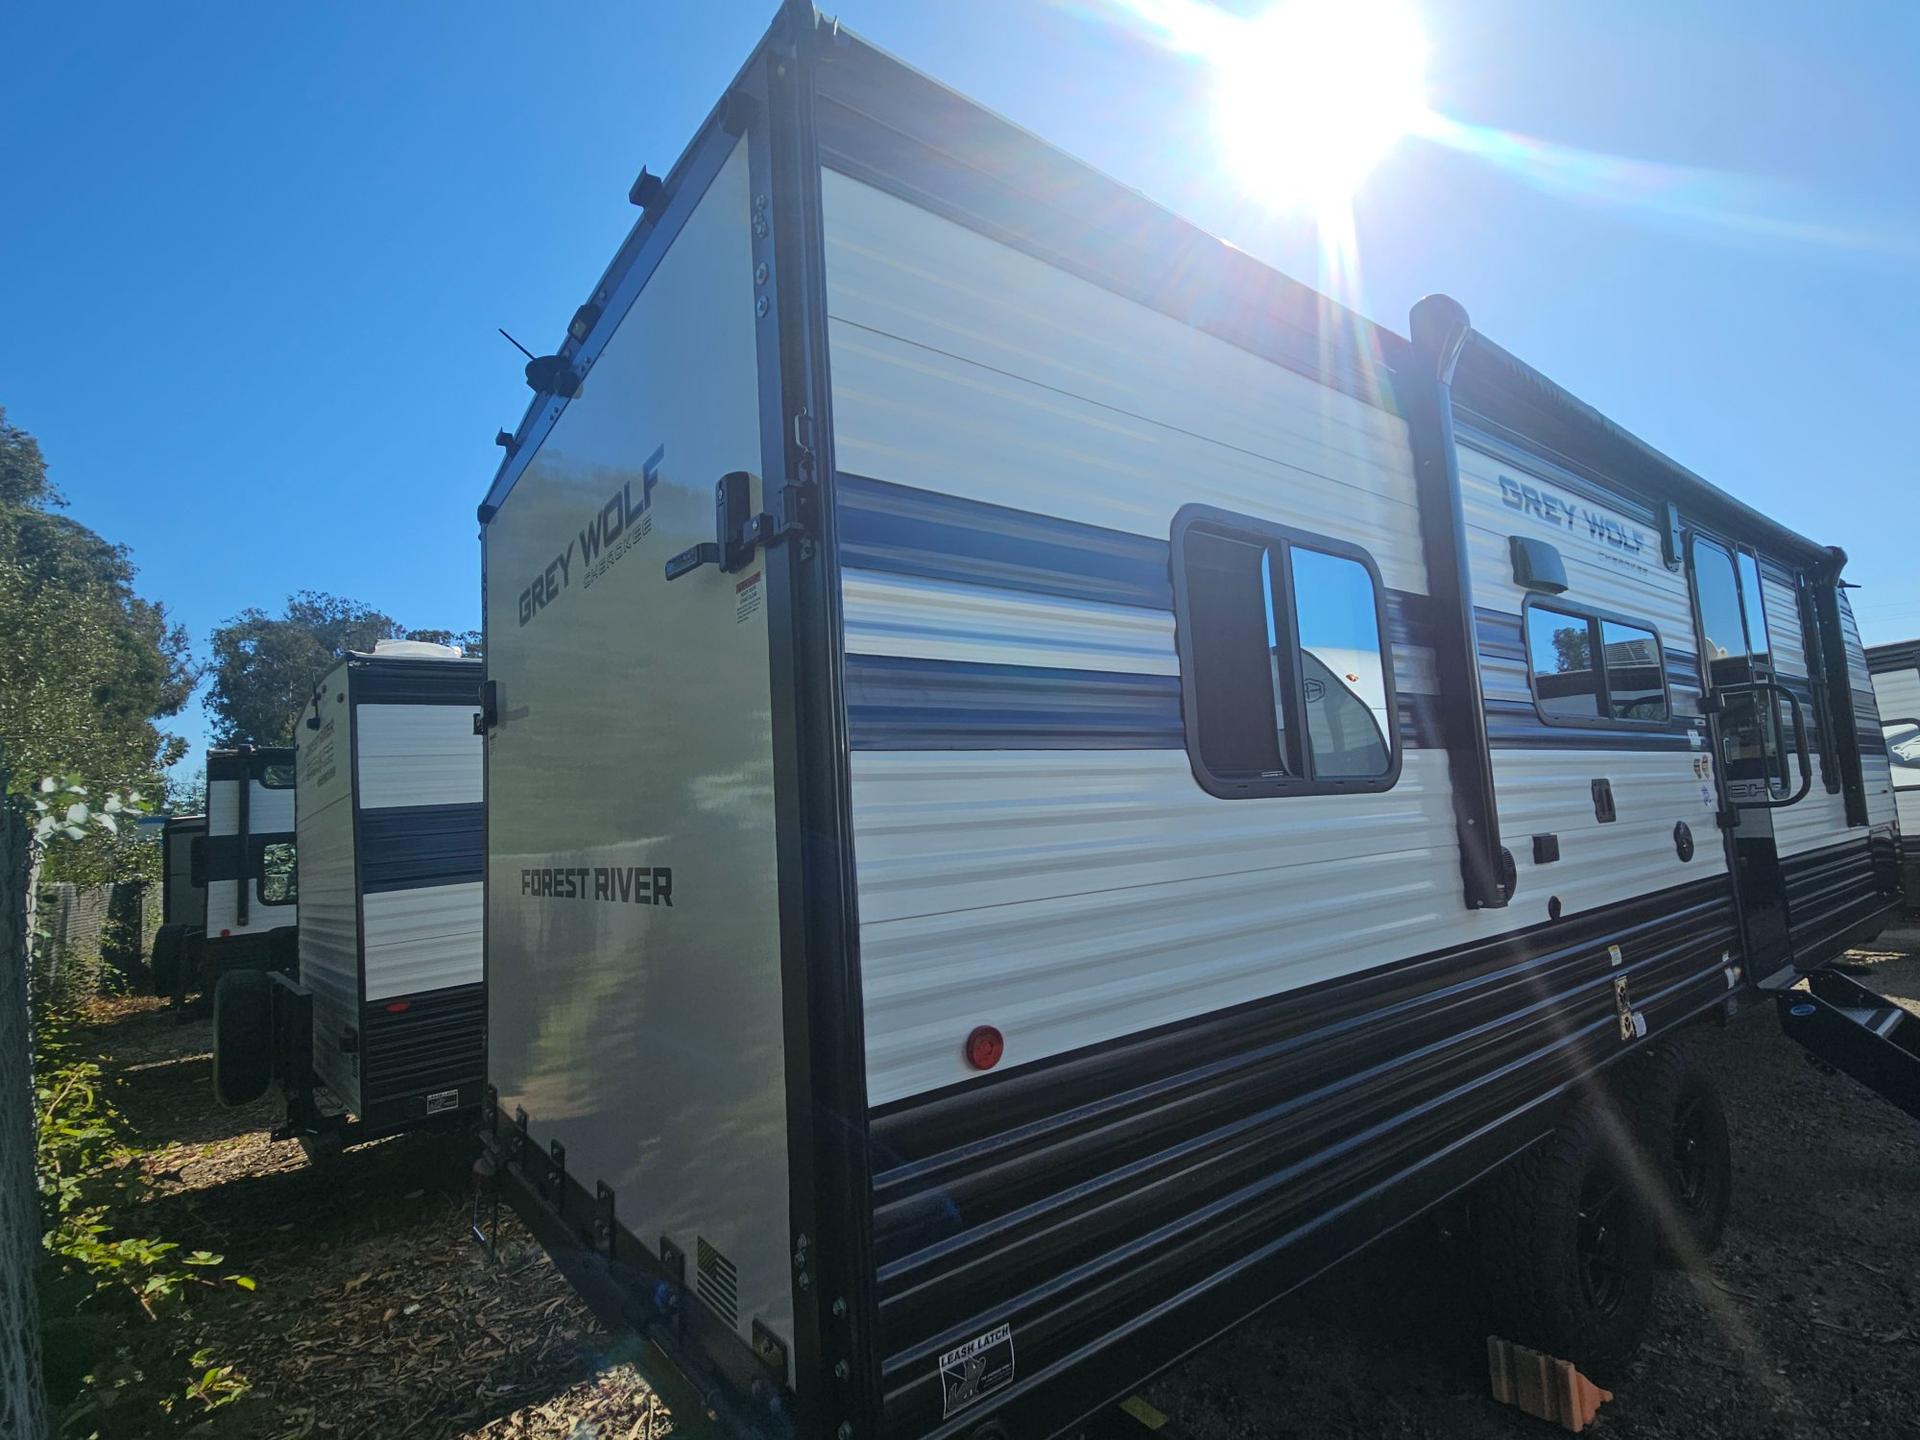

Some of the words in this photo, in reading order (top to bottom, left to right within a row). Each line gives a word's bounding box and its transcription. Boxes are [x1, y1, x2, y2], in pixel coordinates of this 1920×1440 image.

[518, 539, 575, 628] GREY
[579, 443, 664, 568] WOLF
[1498, 475, 1576, 530] GREY
[1582, 508, 1645, 555] WOLF
[521, 868, 590, 899] FOREST
[594, 867, 673, 907] RIVER
[941, 1343, 975, 1367] LEASH
[977, 1326, 1009, 1349] LATCH
